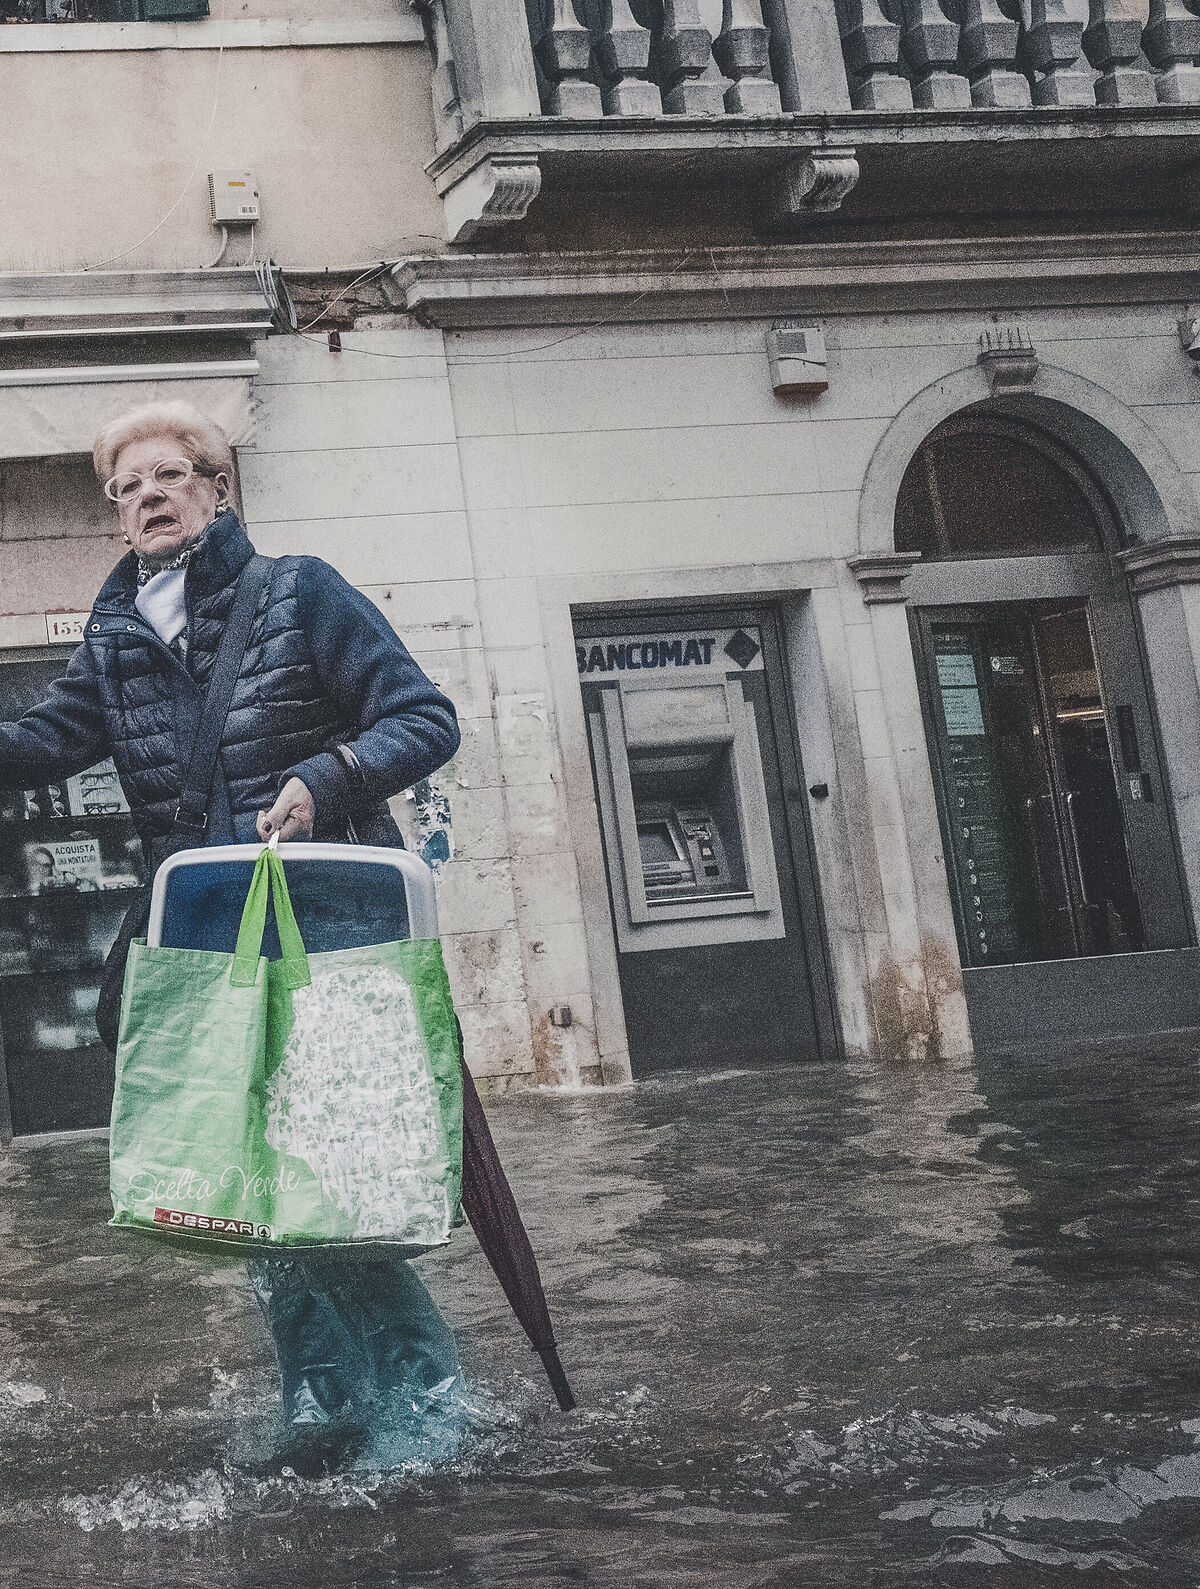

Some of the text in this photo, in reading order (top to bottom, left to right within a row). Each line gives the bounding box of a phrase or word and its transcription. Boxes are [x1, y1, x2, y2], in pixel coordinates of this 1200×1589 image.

[576, 638, 716, 673] BANCOMAT
[55, 845, 95, 855] ACQUISTA
[128, 1166, 301, 1204] Scelta Verde
[169, 1211, 254, 1236] DESPAR
